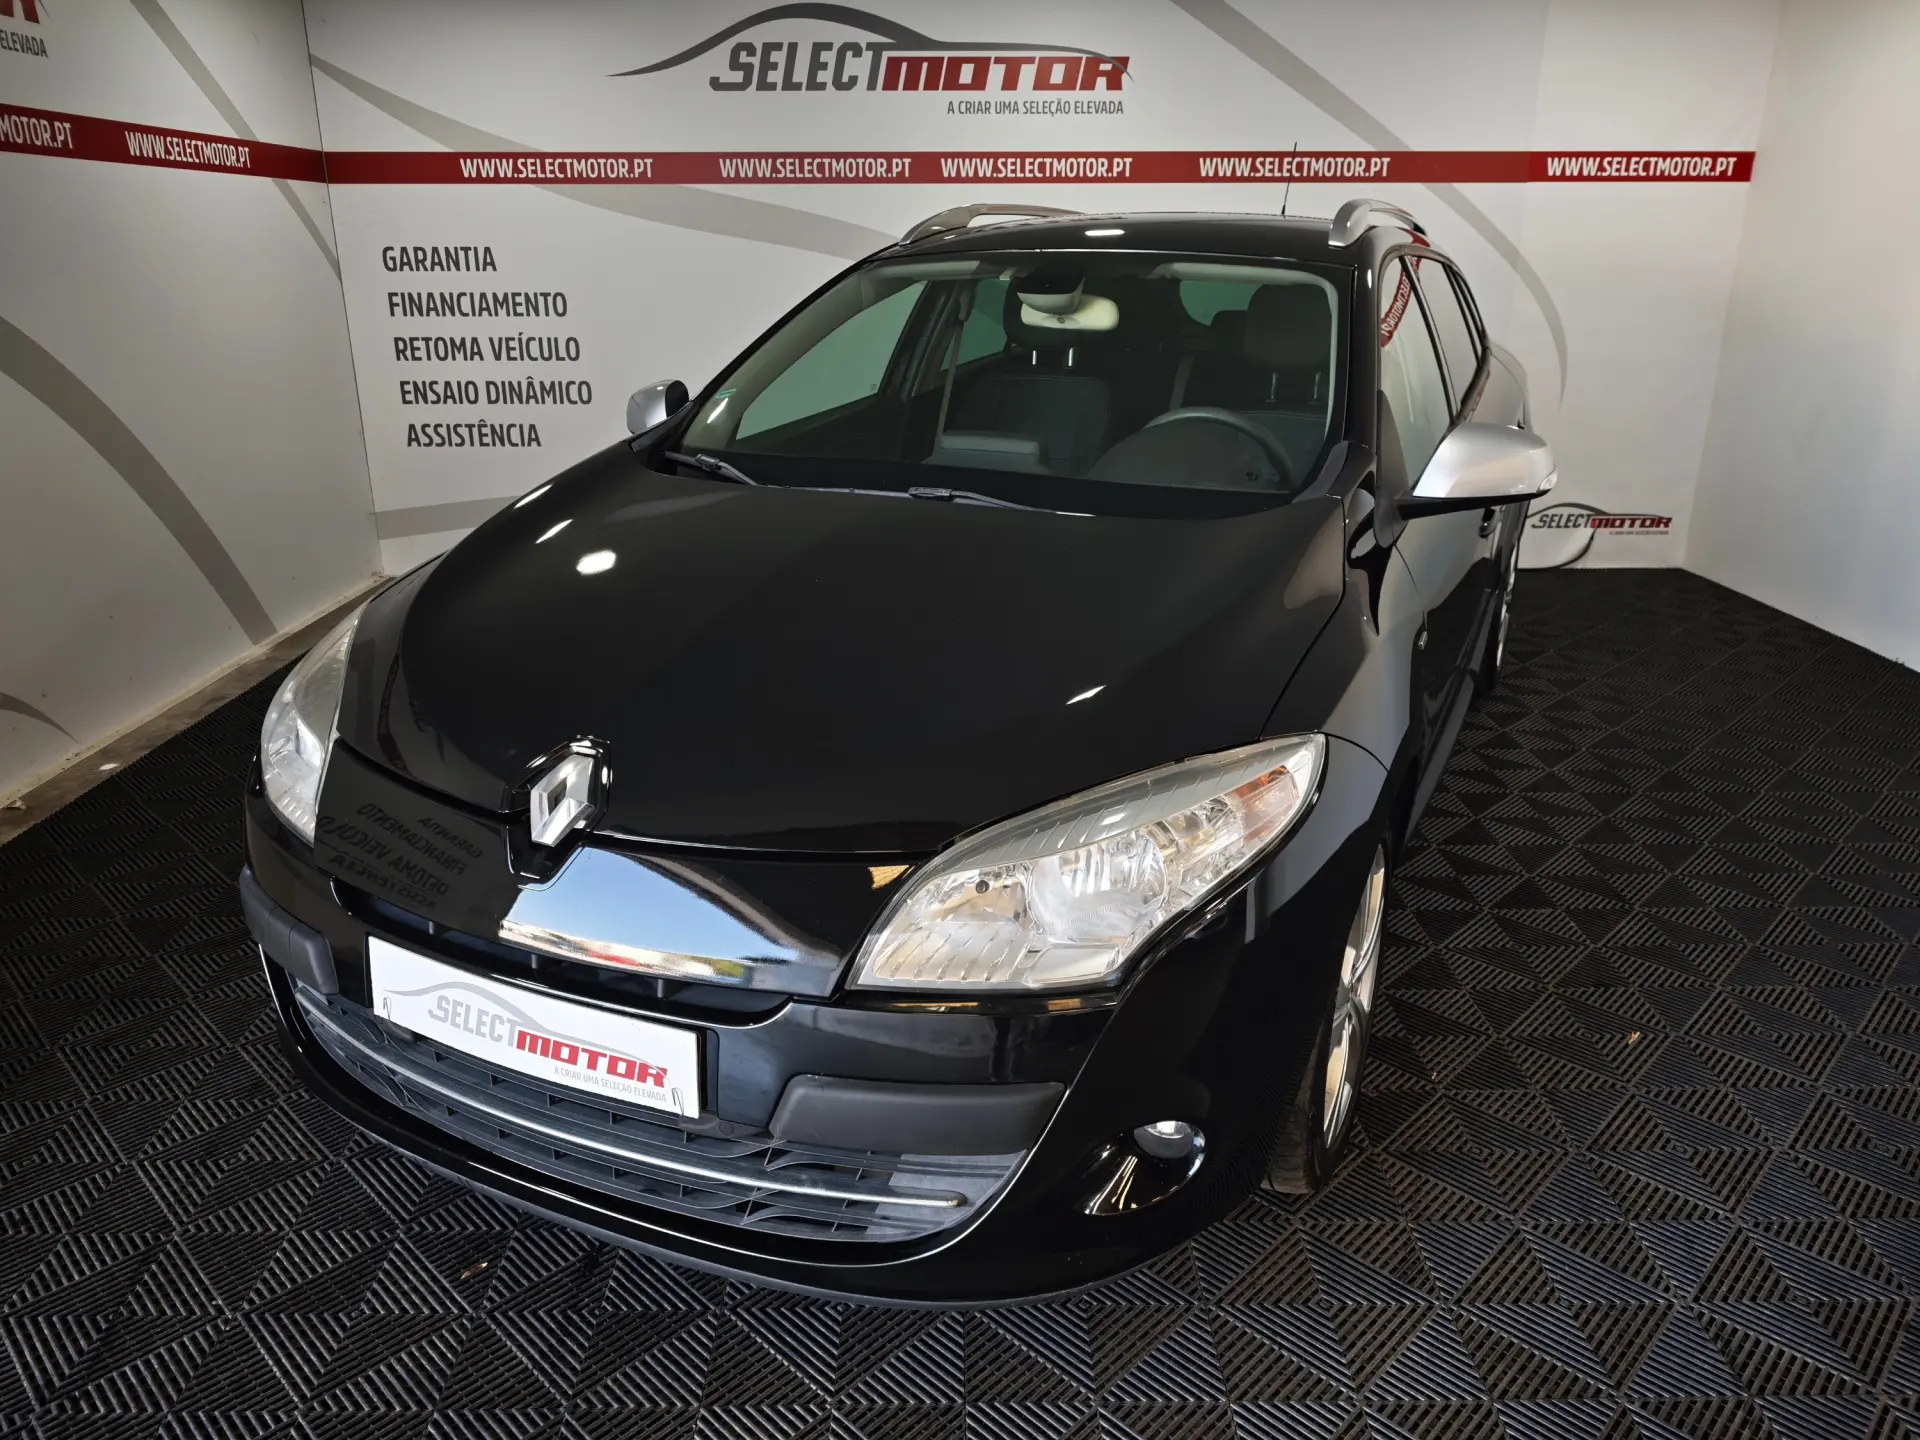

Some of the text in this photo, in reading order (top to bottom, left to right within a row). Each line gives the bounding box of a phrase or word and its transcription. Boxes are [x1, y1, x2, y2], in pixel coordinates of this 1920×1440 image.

[0, 29, 48, 58] ELEVADA
[947, 98, 1124, 116] A CRIAR UMA SELEÇÃO ELEVADA
[125, 131, 250, 168] WWW.SELECTMOTOR.PT
[460, 157, 1737, 178] WWW.SELECTMOTOR.PT WWW.SELECTMOTOR.PT WWW.SELECTMOTOR.PT WWW.SELECTMOTOR.PT WWW.SELECTMOTOR.PT
[382, 246, 497, 272] GARANTIA
[387, 292, 568, 317] FINANCIAMENTO
[393, 332, 580, 361] RETOMA VEÍCULO
[400, 376, 592, 405] ENSAIO DINÂMICO
[407, 419, 542, 447] ASSISTÊNCIA
[561, 1067, 582, 1080] CRIAR
[583, 1074, 599, 1086] UMA
[634, 1086, 667, 1103] ELEVADA
